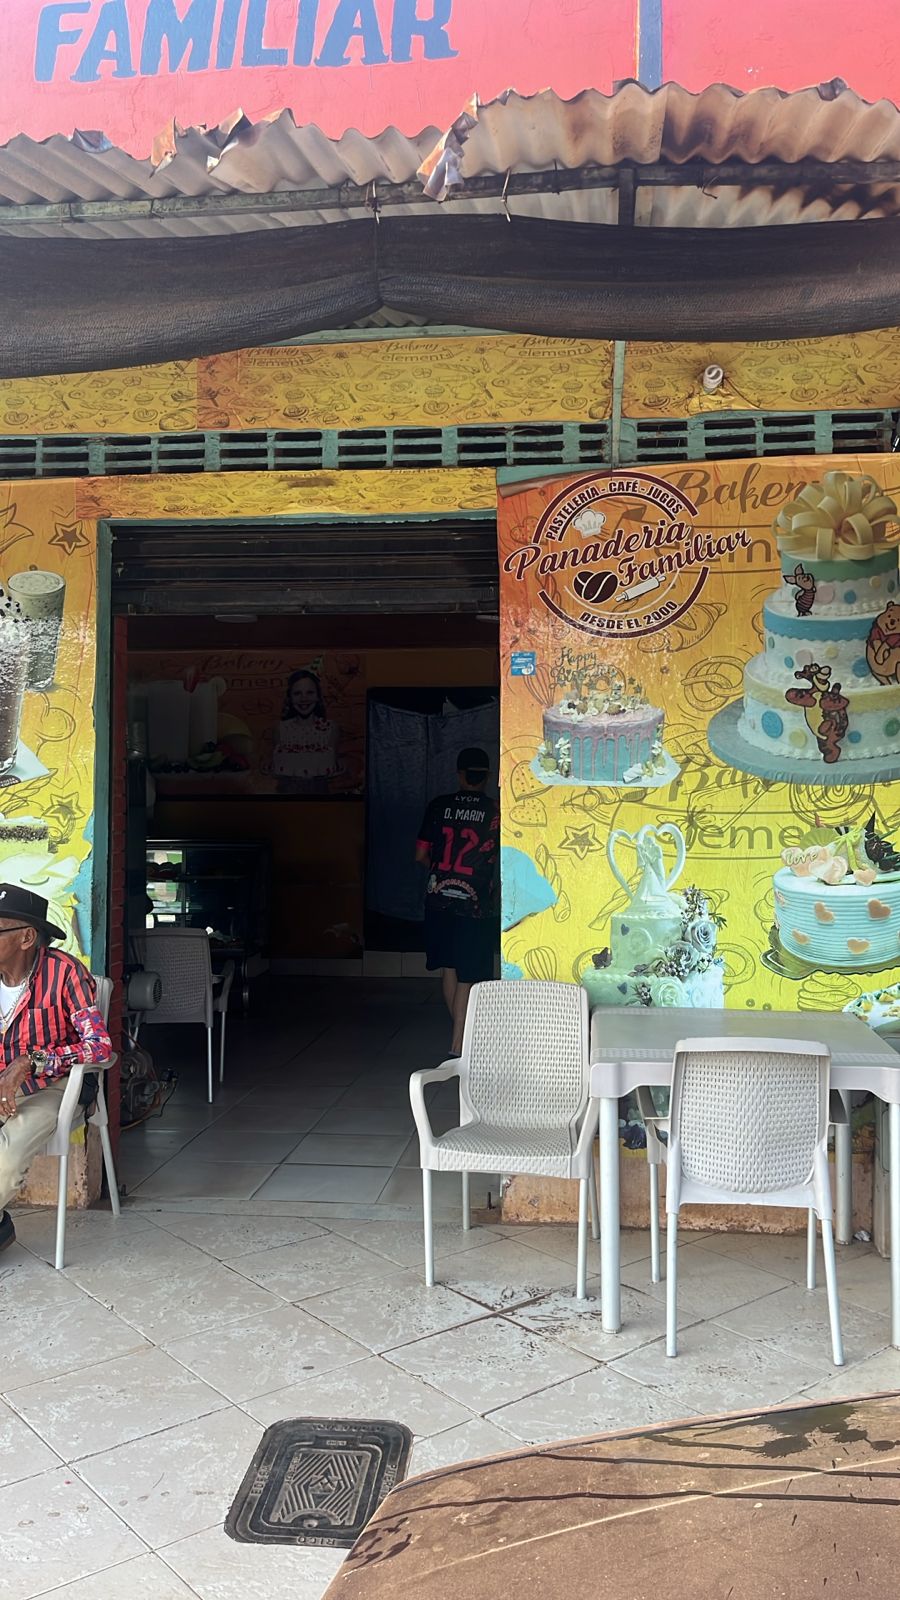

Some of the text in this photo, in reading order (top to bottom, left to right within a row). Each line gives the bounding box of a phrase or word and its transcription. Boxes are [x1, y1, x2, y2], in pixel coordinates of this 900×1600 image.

[34, 0, 459, 82] FAMILIAR
[608, 480, 640, 494] CAFÉ
[646, 485, 684, 515] JUGOS
[661, 462, 820, 514] Baker
[503, 519, 692, 580] Panaderia
[618, 529, 752, 587] Familiar
[580, 600, 679, 630] DESDE EL 2000
[554, 646, 597, 670] Happy
[443, 807, 485, 822] D. MARIN
[455, 795, 480, 803] LYON
[438, 827, 480, 875] 12
[297, 1535, 337, 1546] RICO
